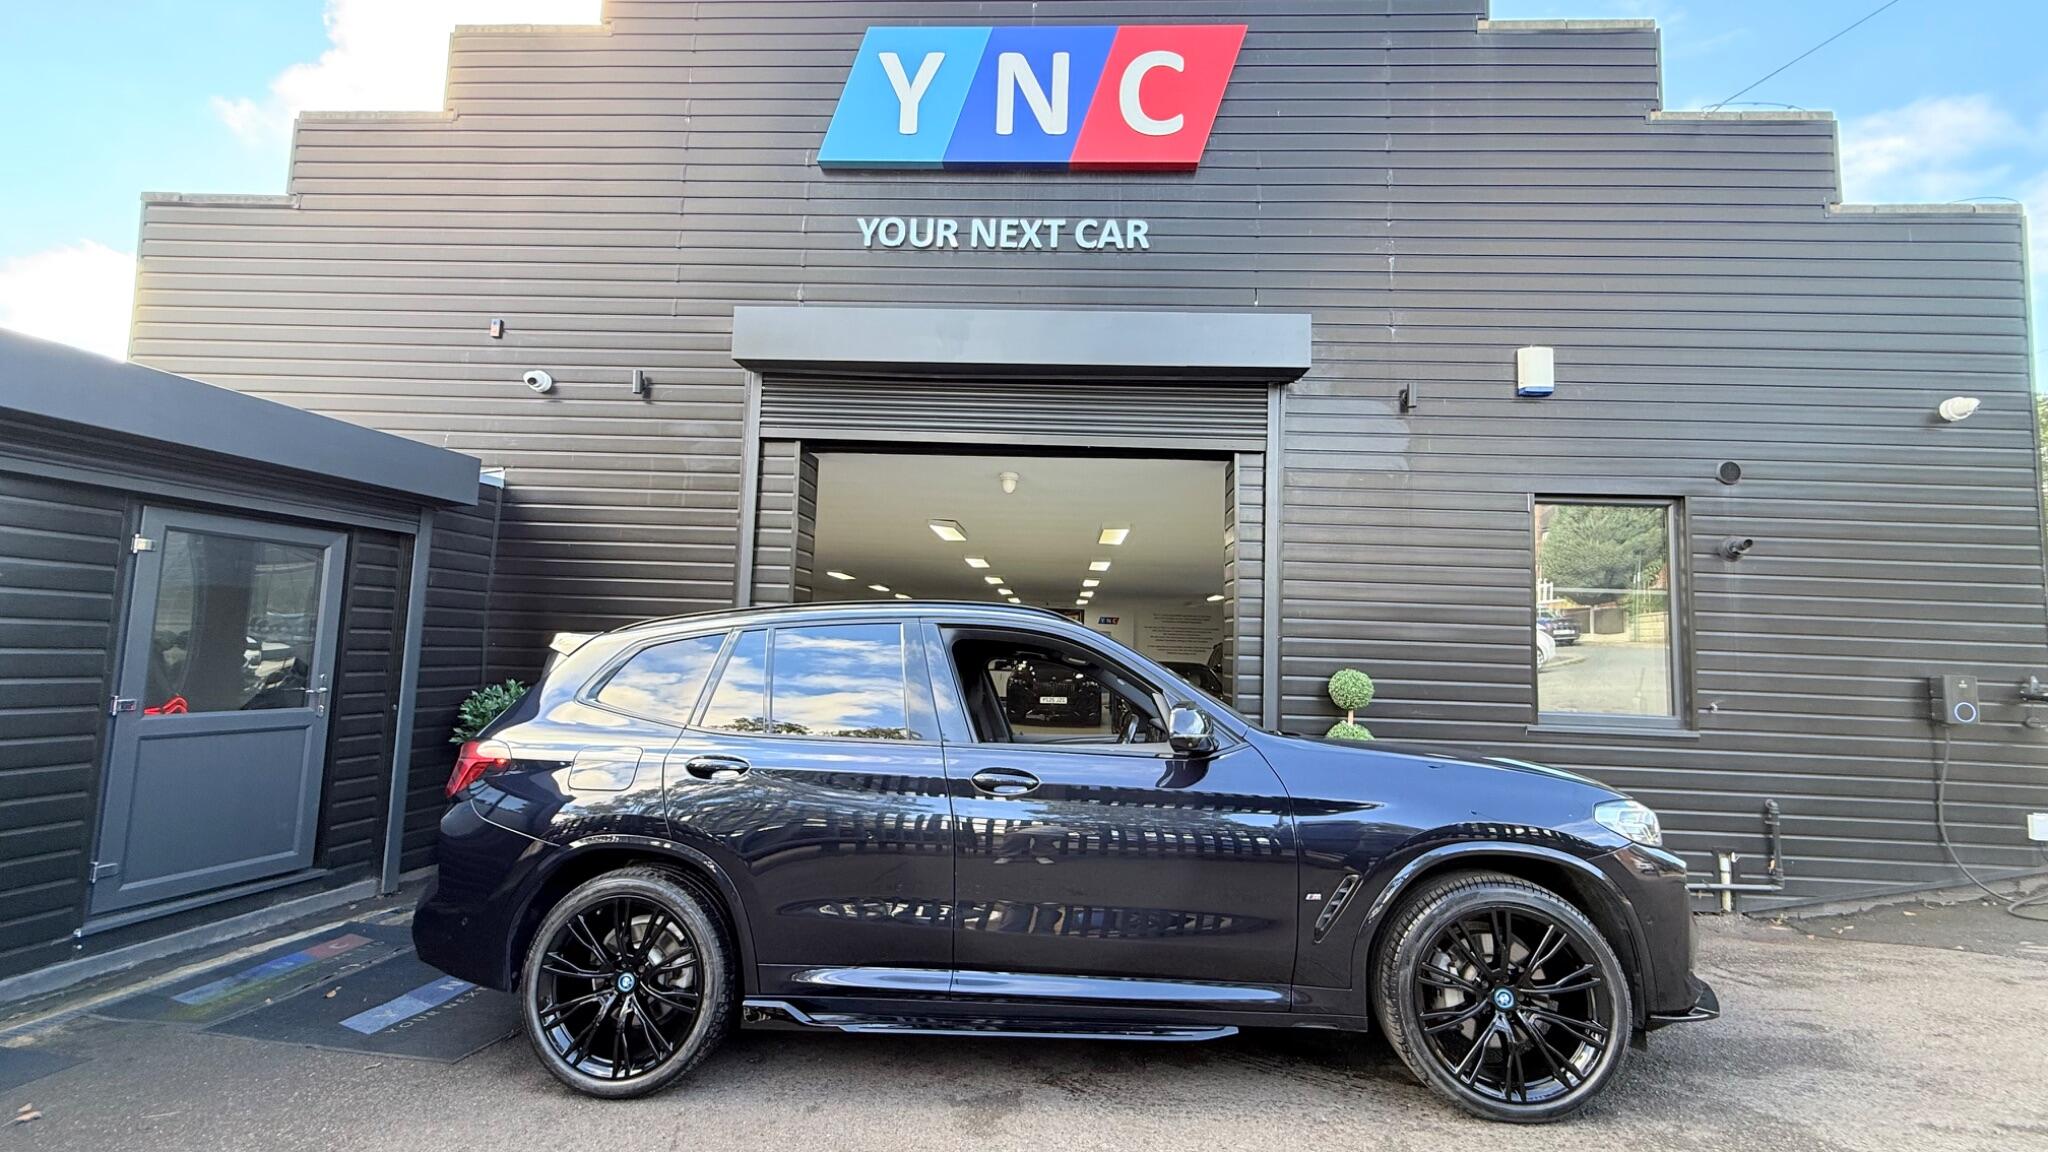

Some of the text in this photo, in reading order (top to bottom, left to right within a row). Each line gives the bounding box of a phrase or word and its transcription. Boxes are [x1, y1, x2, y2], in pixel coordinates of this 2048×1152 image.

[878, 50, 1186, 136] YNC
[857, 217, 1150, 250] YOUR NEXT CAR
[373, 979, 465, 1018] YN
[384, 1011, 440, 1034] YOUR
